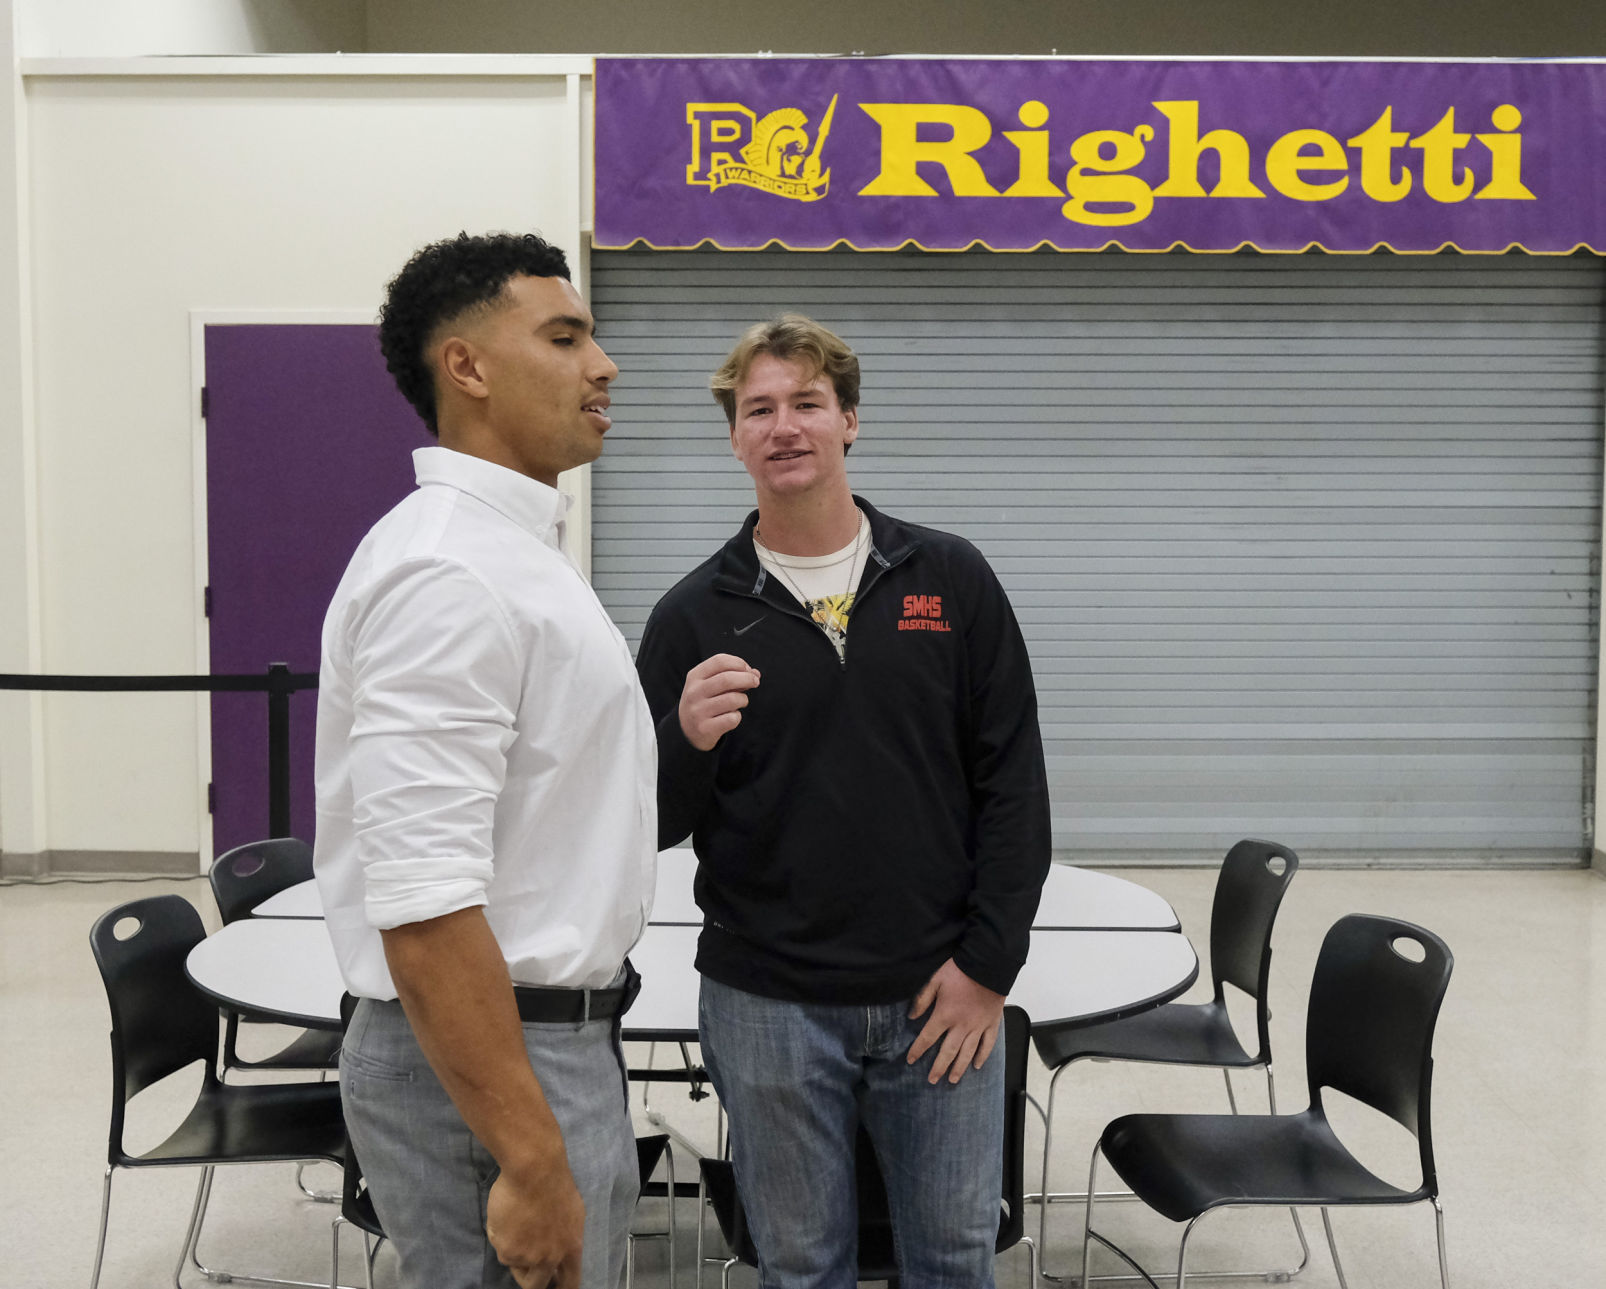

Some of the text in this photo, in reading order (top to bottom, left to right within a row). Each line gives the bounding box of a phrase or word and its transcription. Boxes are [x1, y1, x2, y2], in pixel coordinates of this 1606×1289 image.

[857, 100, 1537, 227] Righetti
[726, 167, 808, 196] WARRIORS
[903, 594, 942, 618] SMHS
[897, 619, 951, 632] BASKETBALL
